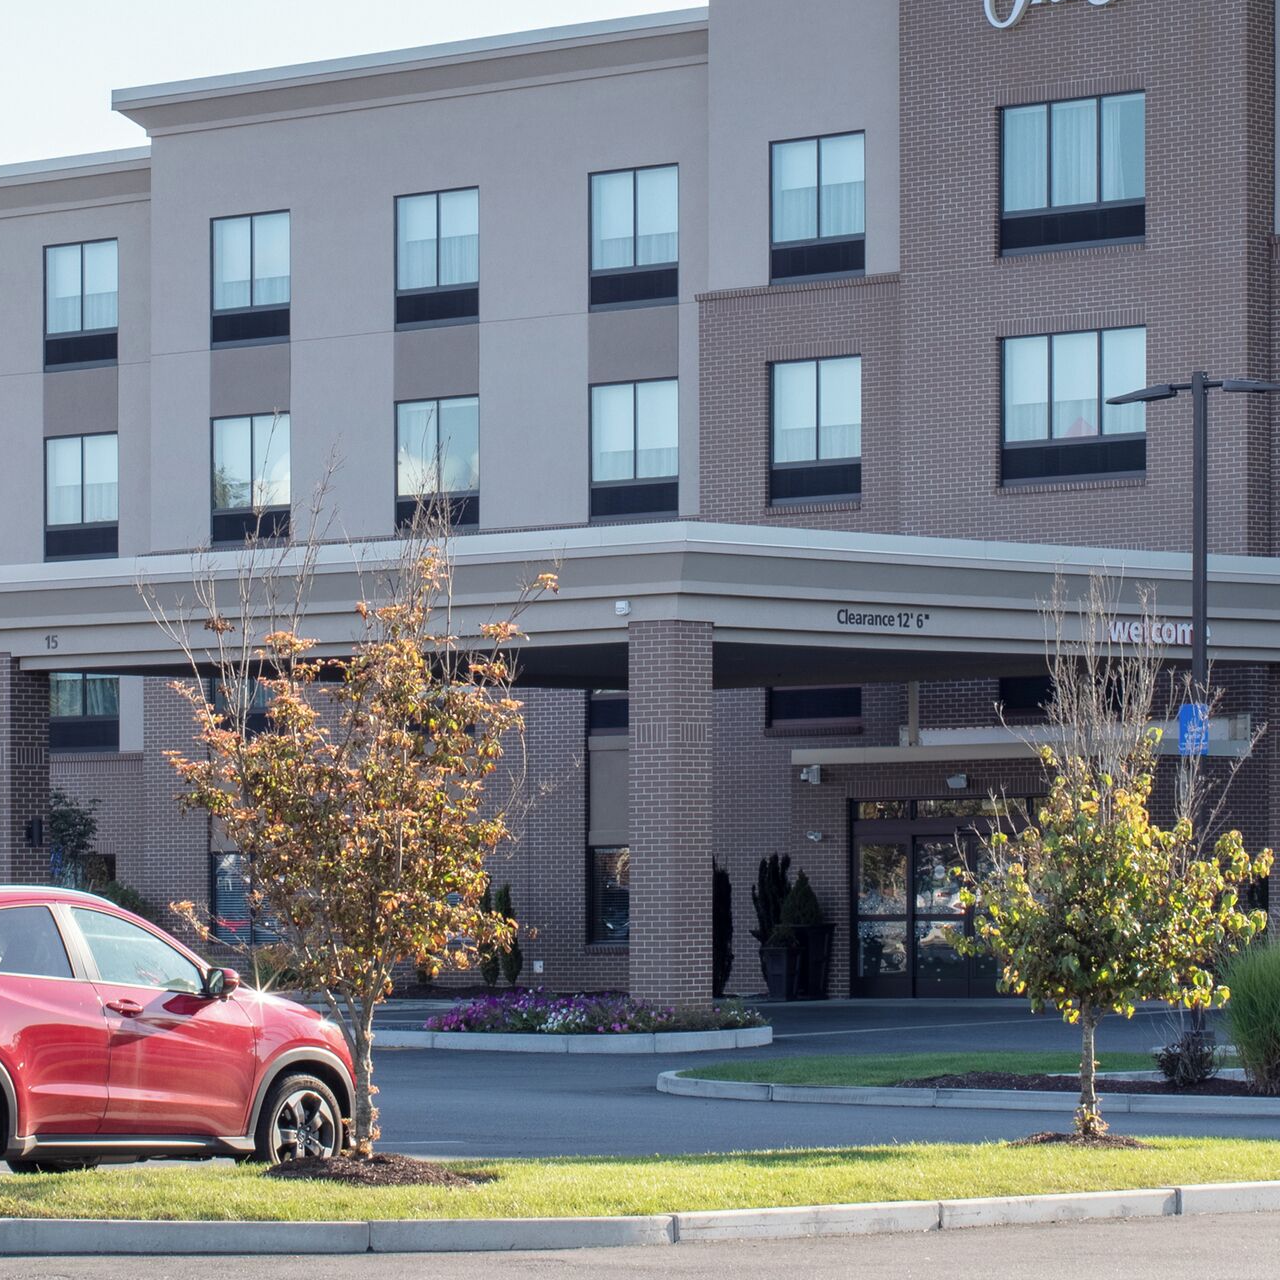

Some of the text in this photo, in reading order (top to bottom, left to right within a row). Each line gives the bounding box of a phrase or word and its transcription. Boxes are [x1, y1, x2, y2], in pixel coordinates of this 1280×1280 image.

[837, 608, 895, 626] Clearance
[897, 612, 914, 628] 12'
[45, 634, 58, 650] 15
